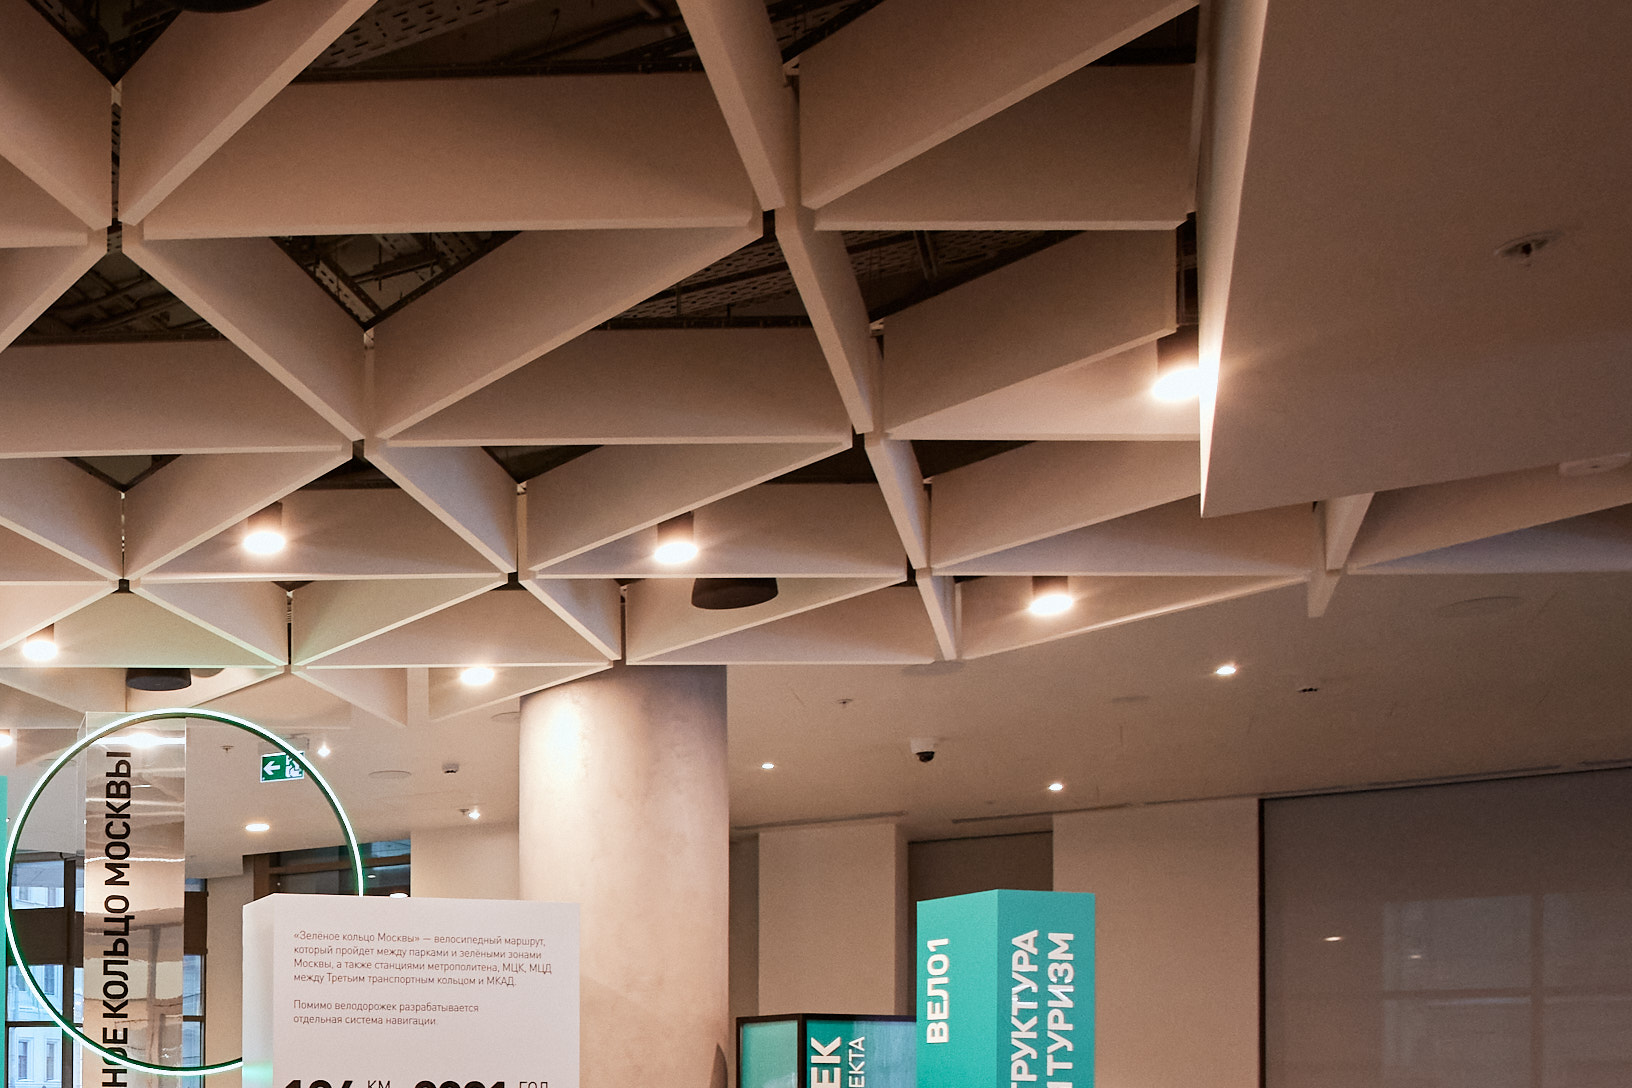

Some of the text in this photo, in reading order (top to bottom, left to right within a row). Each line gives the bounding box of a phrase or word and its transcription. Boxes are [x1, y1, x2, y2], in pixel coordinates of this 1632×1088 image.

[104, 751, 132, 886] МОСКВЫ
[293, 930, 340, 940] «Зелёное
[342, 933, 375, 942] кольцо
[377, 932, 419, 942] Москвы»
[433, 935, 501, 944] велосипедный
[102, 894, 136, 1020] КОЛЬЦО
[293, 945, 332, 955] который
[335, 945, 374, 956] пройдет
[376, 948, 407, 957] между
[529, 963, 552, 974] МЦД
[293, 974, 324, 983] между
[326, 972, 364, 982] Третьим
[367, 975, 434, 984] транспортным
[927, 939, 949, 1044] ВЕЛО1
[293, 999, 478, 1012] Помимо велодорожек разрабатывается
[1047, 933, 1075, 1075] ТУРИЗМ
[293, 1015, 342, 1023] отдельная
[344, 1016, 383, 1024] система
